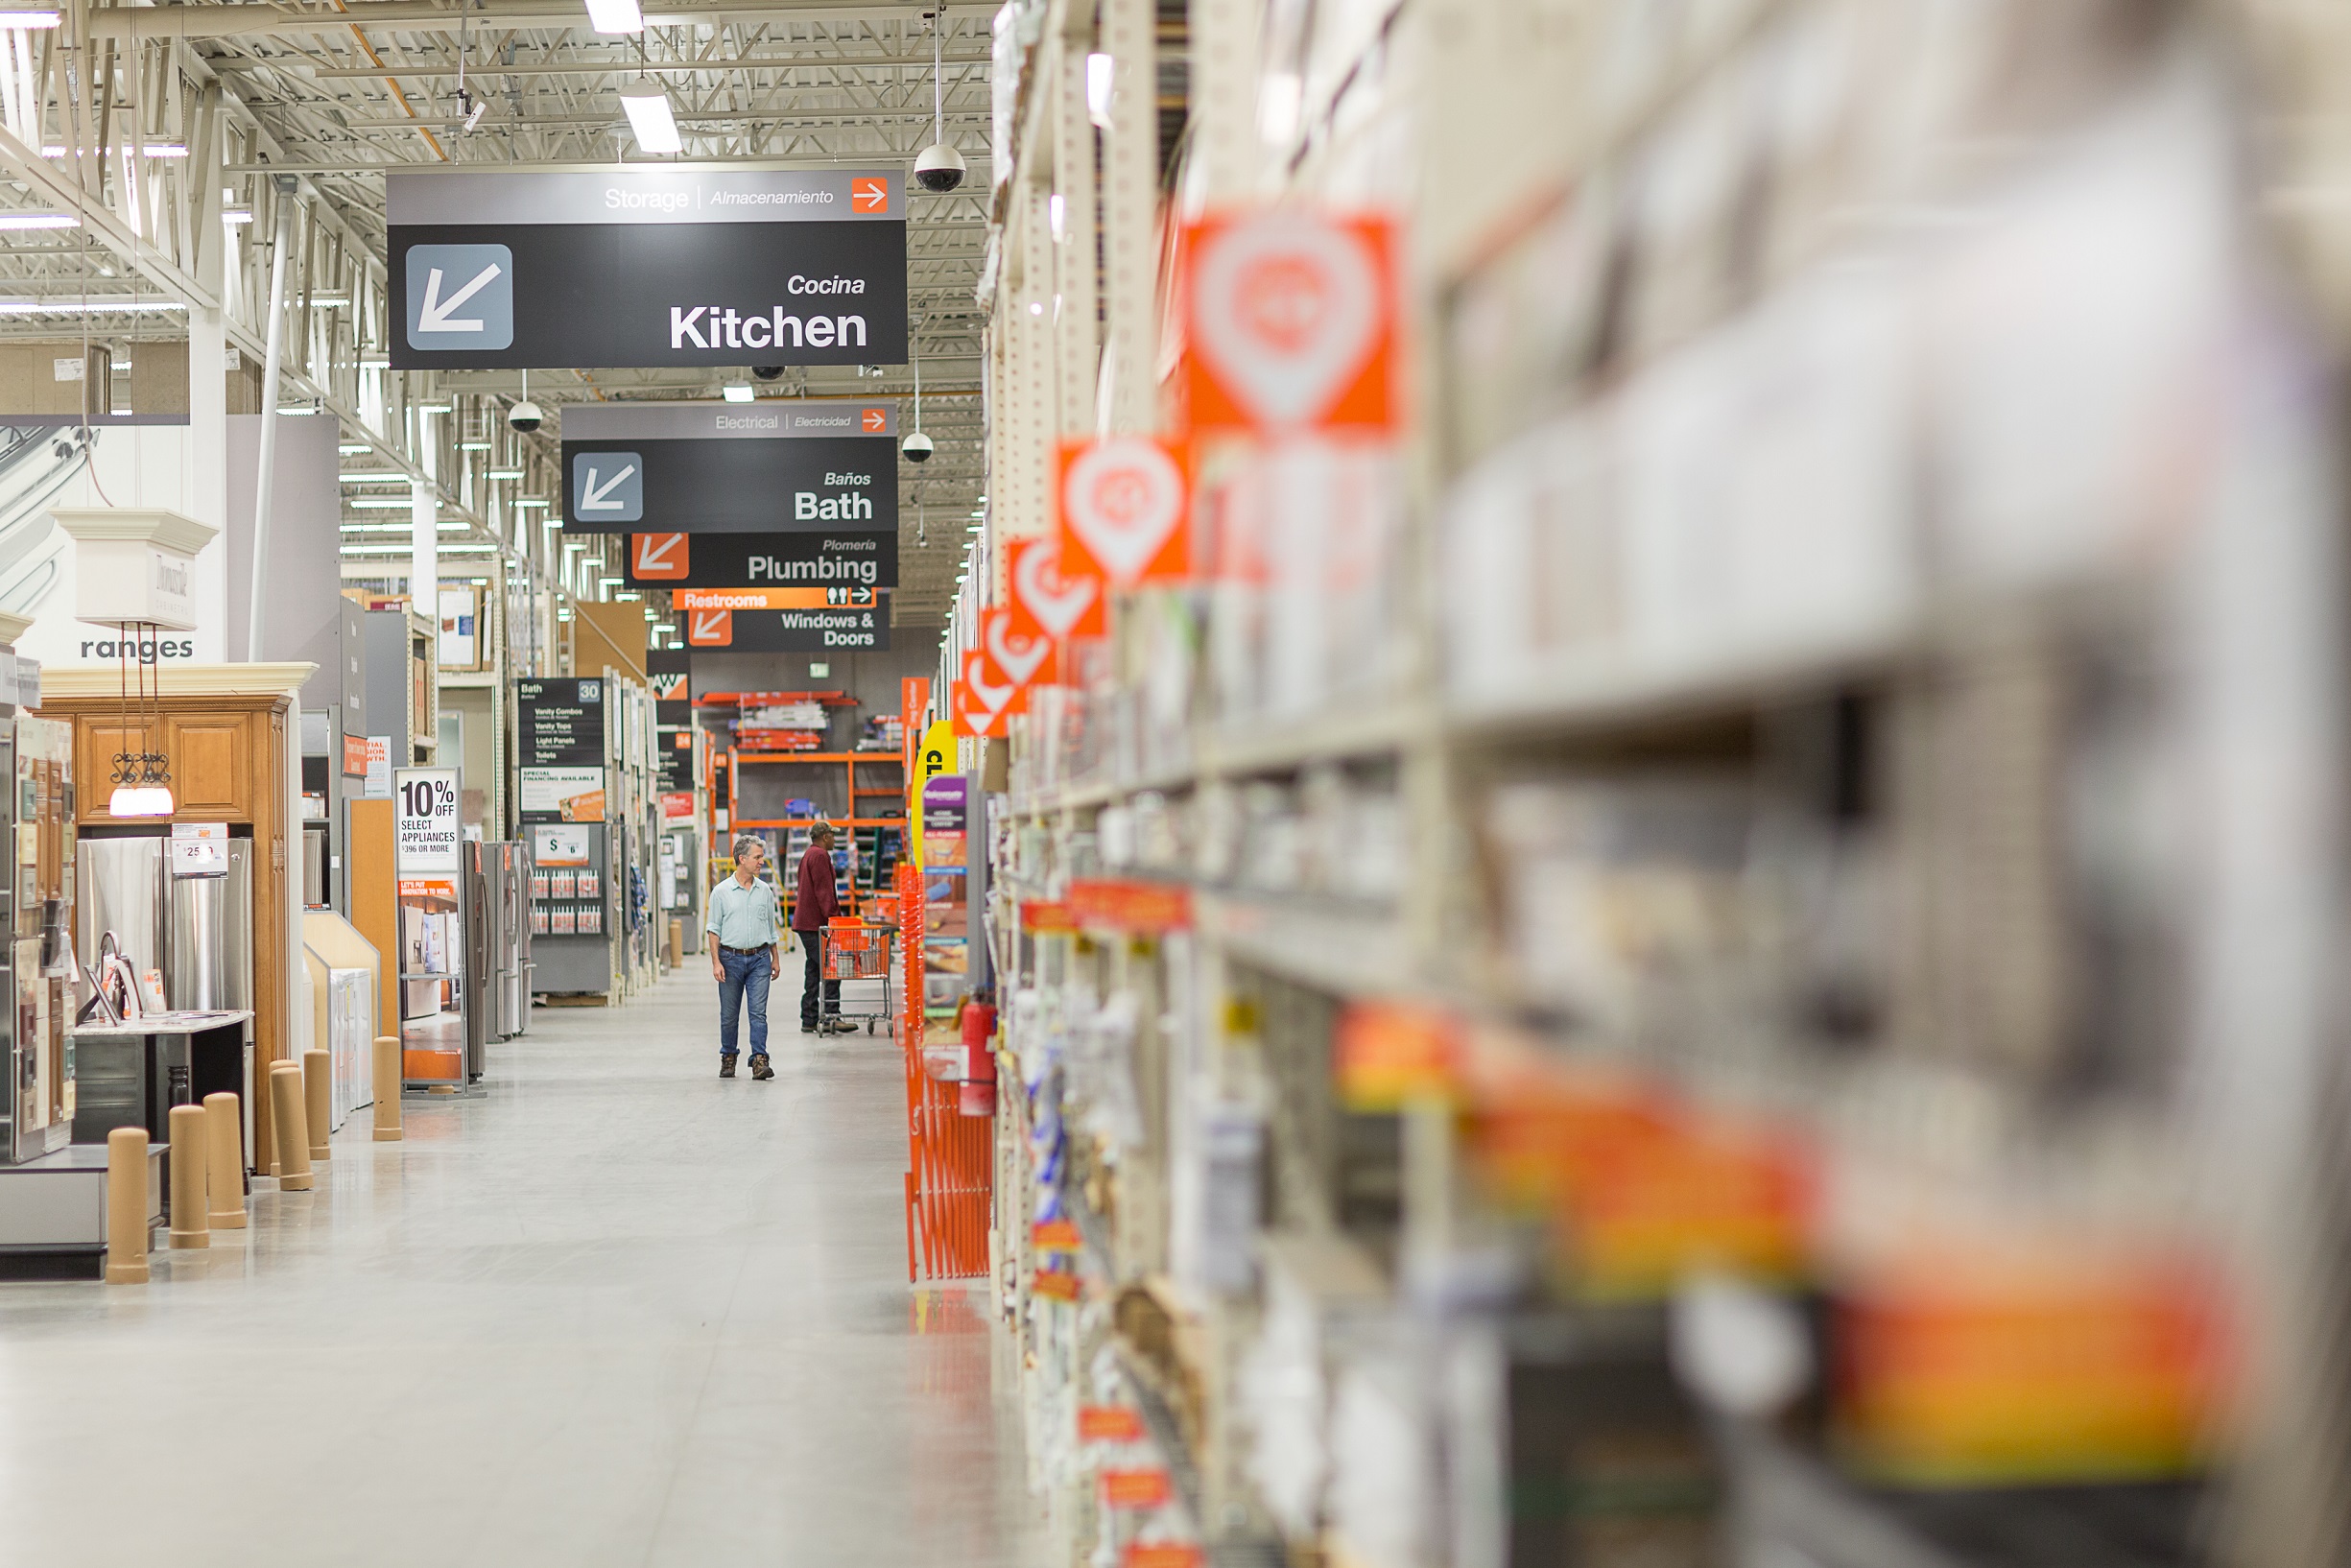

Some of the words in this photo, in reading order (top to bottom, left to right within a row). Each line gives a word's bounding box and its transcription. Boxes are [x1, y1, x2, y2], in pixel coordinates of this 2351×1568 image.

[606, 188, 689, 212] Storage
[710, 190, 834, 206] Almacenamiento
[787, 274, 866, 296] Cocina
[670, 305, 867, 349] Kitchen
[715, 414, 778, 430] Electrical
[795, 416, 851, 428] Electricidad
[824, 471, 871, 487] Baños
[795, 491, 873, 521] Bath
[822, 538, 876, 552] Plomería
[748, 556, 877, 584] Plumbing
[684, 593, 768, 608] Restrooms
[781, 613, 858, 629] Windows
[862, 613, 874, 629] &
[824, 630, 874, 646] Doors
[81, 640, 193, 664] ranges
[521, 683, 543, 694] Bath
[580, 684, 599, 699] 30
[534, 707, 555, 716] Vanity
[534, 723, 555, 731] Vanity
[926, 749, 943, 779] CL
[435, 805, 455, 817] OFF
[401, 820, 433, 830] SELECT
[401, 831, 456, 843] APPLIANCES
[418, 844, 428, 853] OR
[429, 844, 450, 853] MORE
